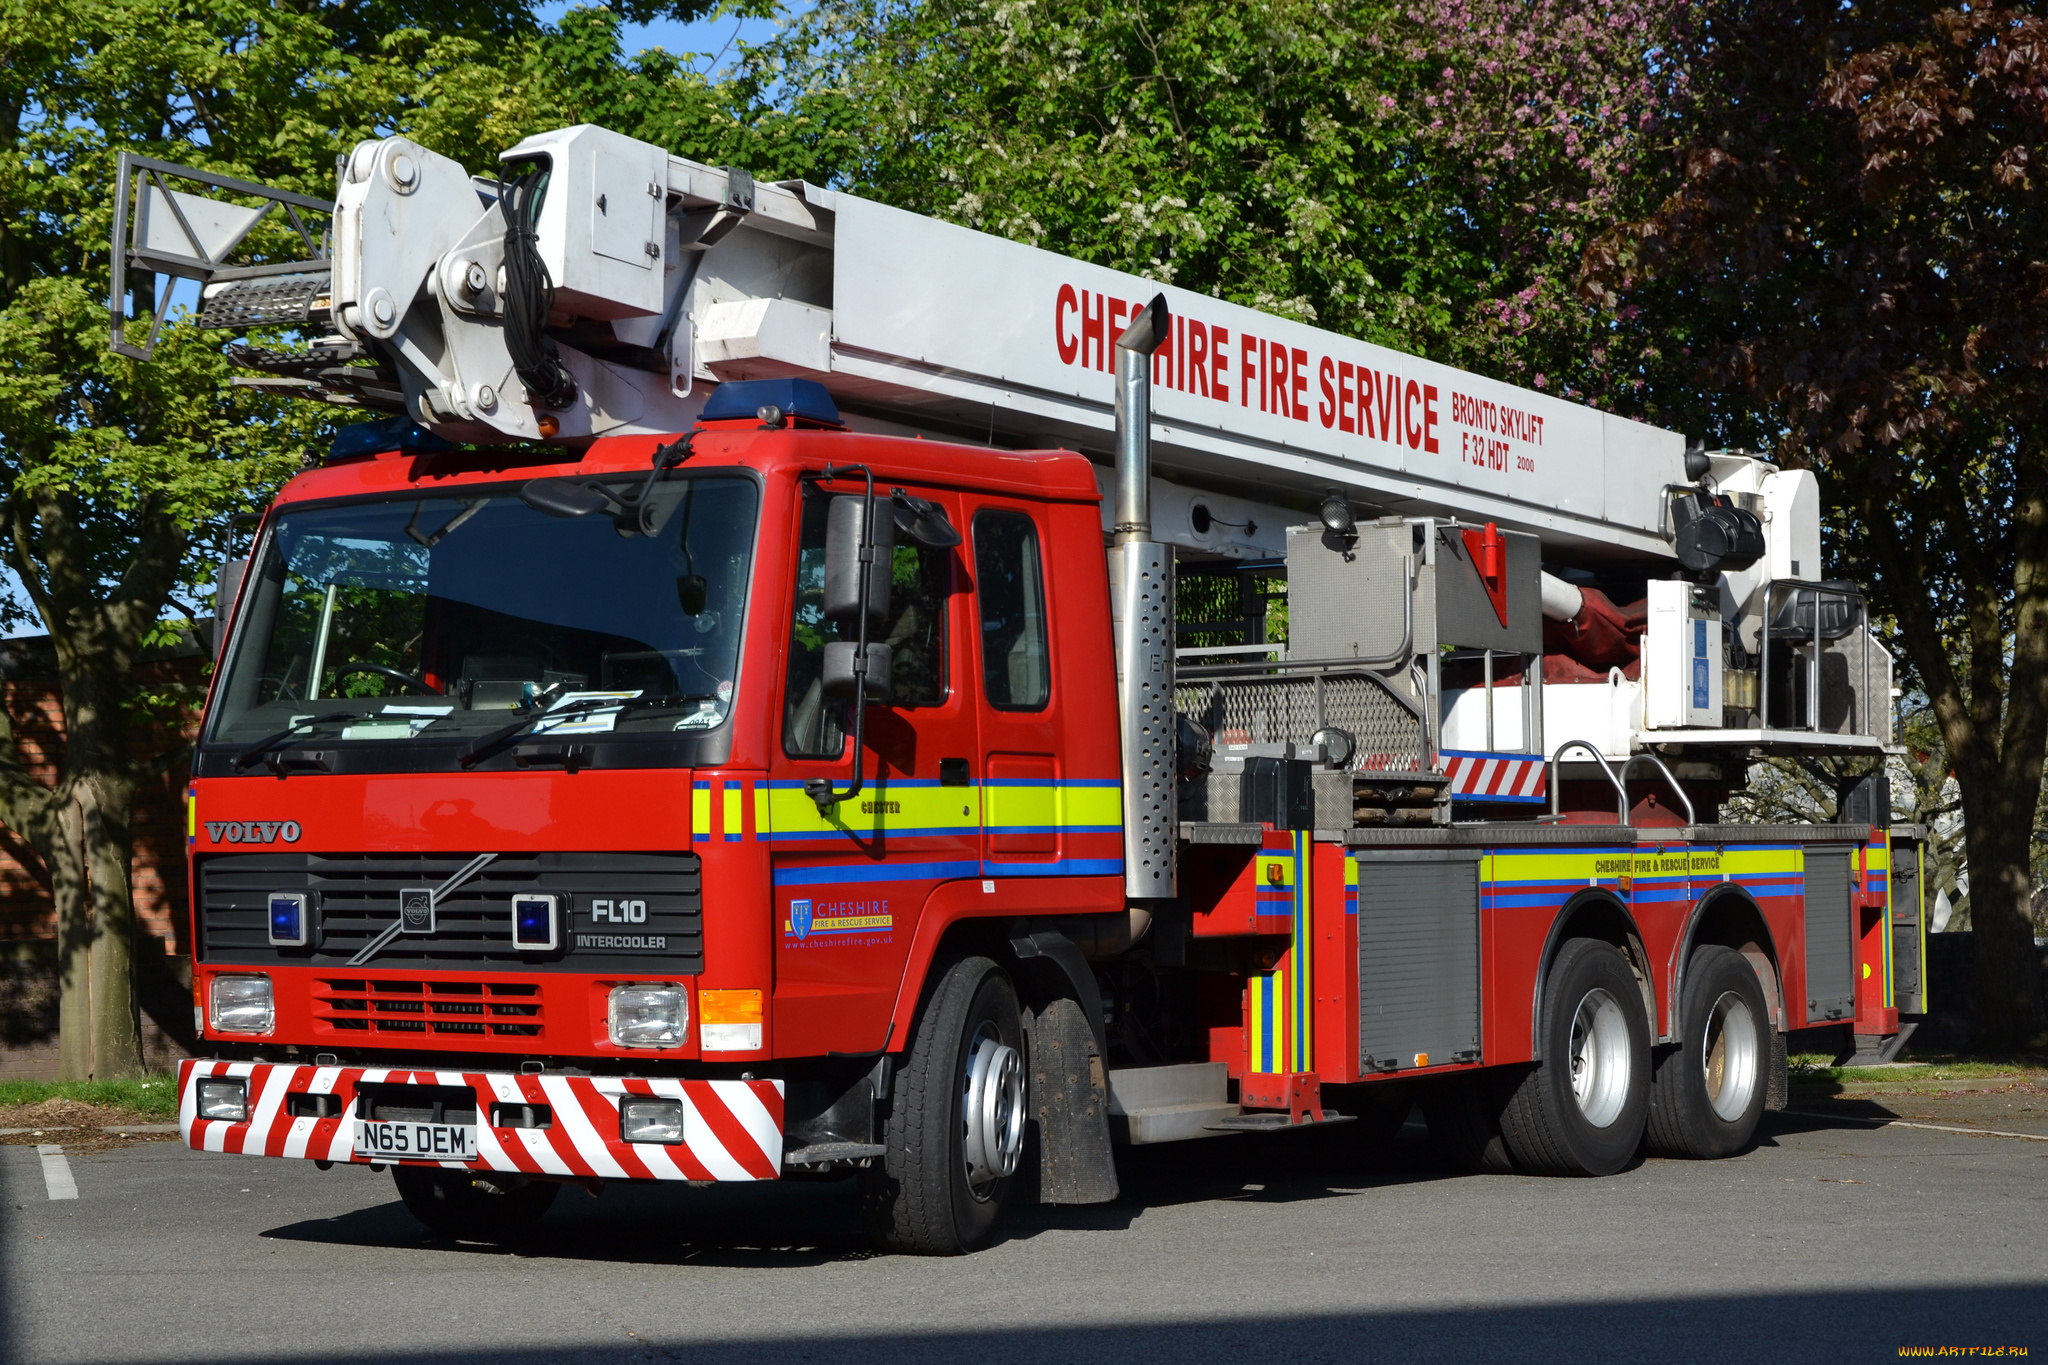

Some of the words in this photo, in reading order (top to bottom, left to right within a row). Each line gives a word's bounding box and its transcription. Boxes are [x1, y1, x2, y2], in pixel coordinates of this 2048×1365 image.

[1055, 283, 1229, 403] CHEHIRE
[1241, 333, 1309, 423] FIRE
[1319, 355, 1439, 454] SERVICE
[1452, 391, 1497, 433] BRONTO
[1500, 405, 1544, 446] SKYLIFT
[1463, 431, 1469, 462] F
[1472, 434, 1485, 467] 32
[1488, 438, 1509, 473] HDT
[1517, 455, 1535, 473] 2000
[861, 800, 901, 814] CHESTER
[204, 821, 302, 844] VOLVO
[1595, 860, 1631, 873] CHESHIRE
[1634, 860, 1651, 873] FIRE
[1653, 860, 1659, 872] &
[1661, 858, 1687, 872] RESCUE
[1691, 857, 1720, 870] SERVICE
[592, 899, 646, 923] FL10
[817, 900, 888, 917] CHESHIRE
[814, 920, 829, 928] FIRE
[831, 920, 836, 928] &
[837, 918, 863, 927] RESCUE
[864, 916, 890, 925] SERVICE
[576, 935, 666, 948] INTERCOOLER
[784, 935, 893, 949] www.cheshirefire.gov.uk
[364, 1123, 409, 1151] N65
[416, 1126, 466, 1154] DEM
